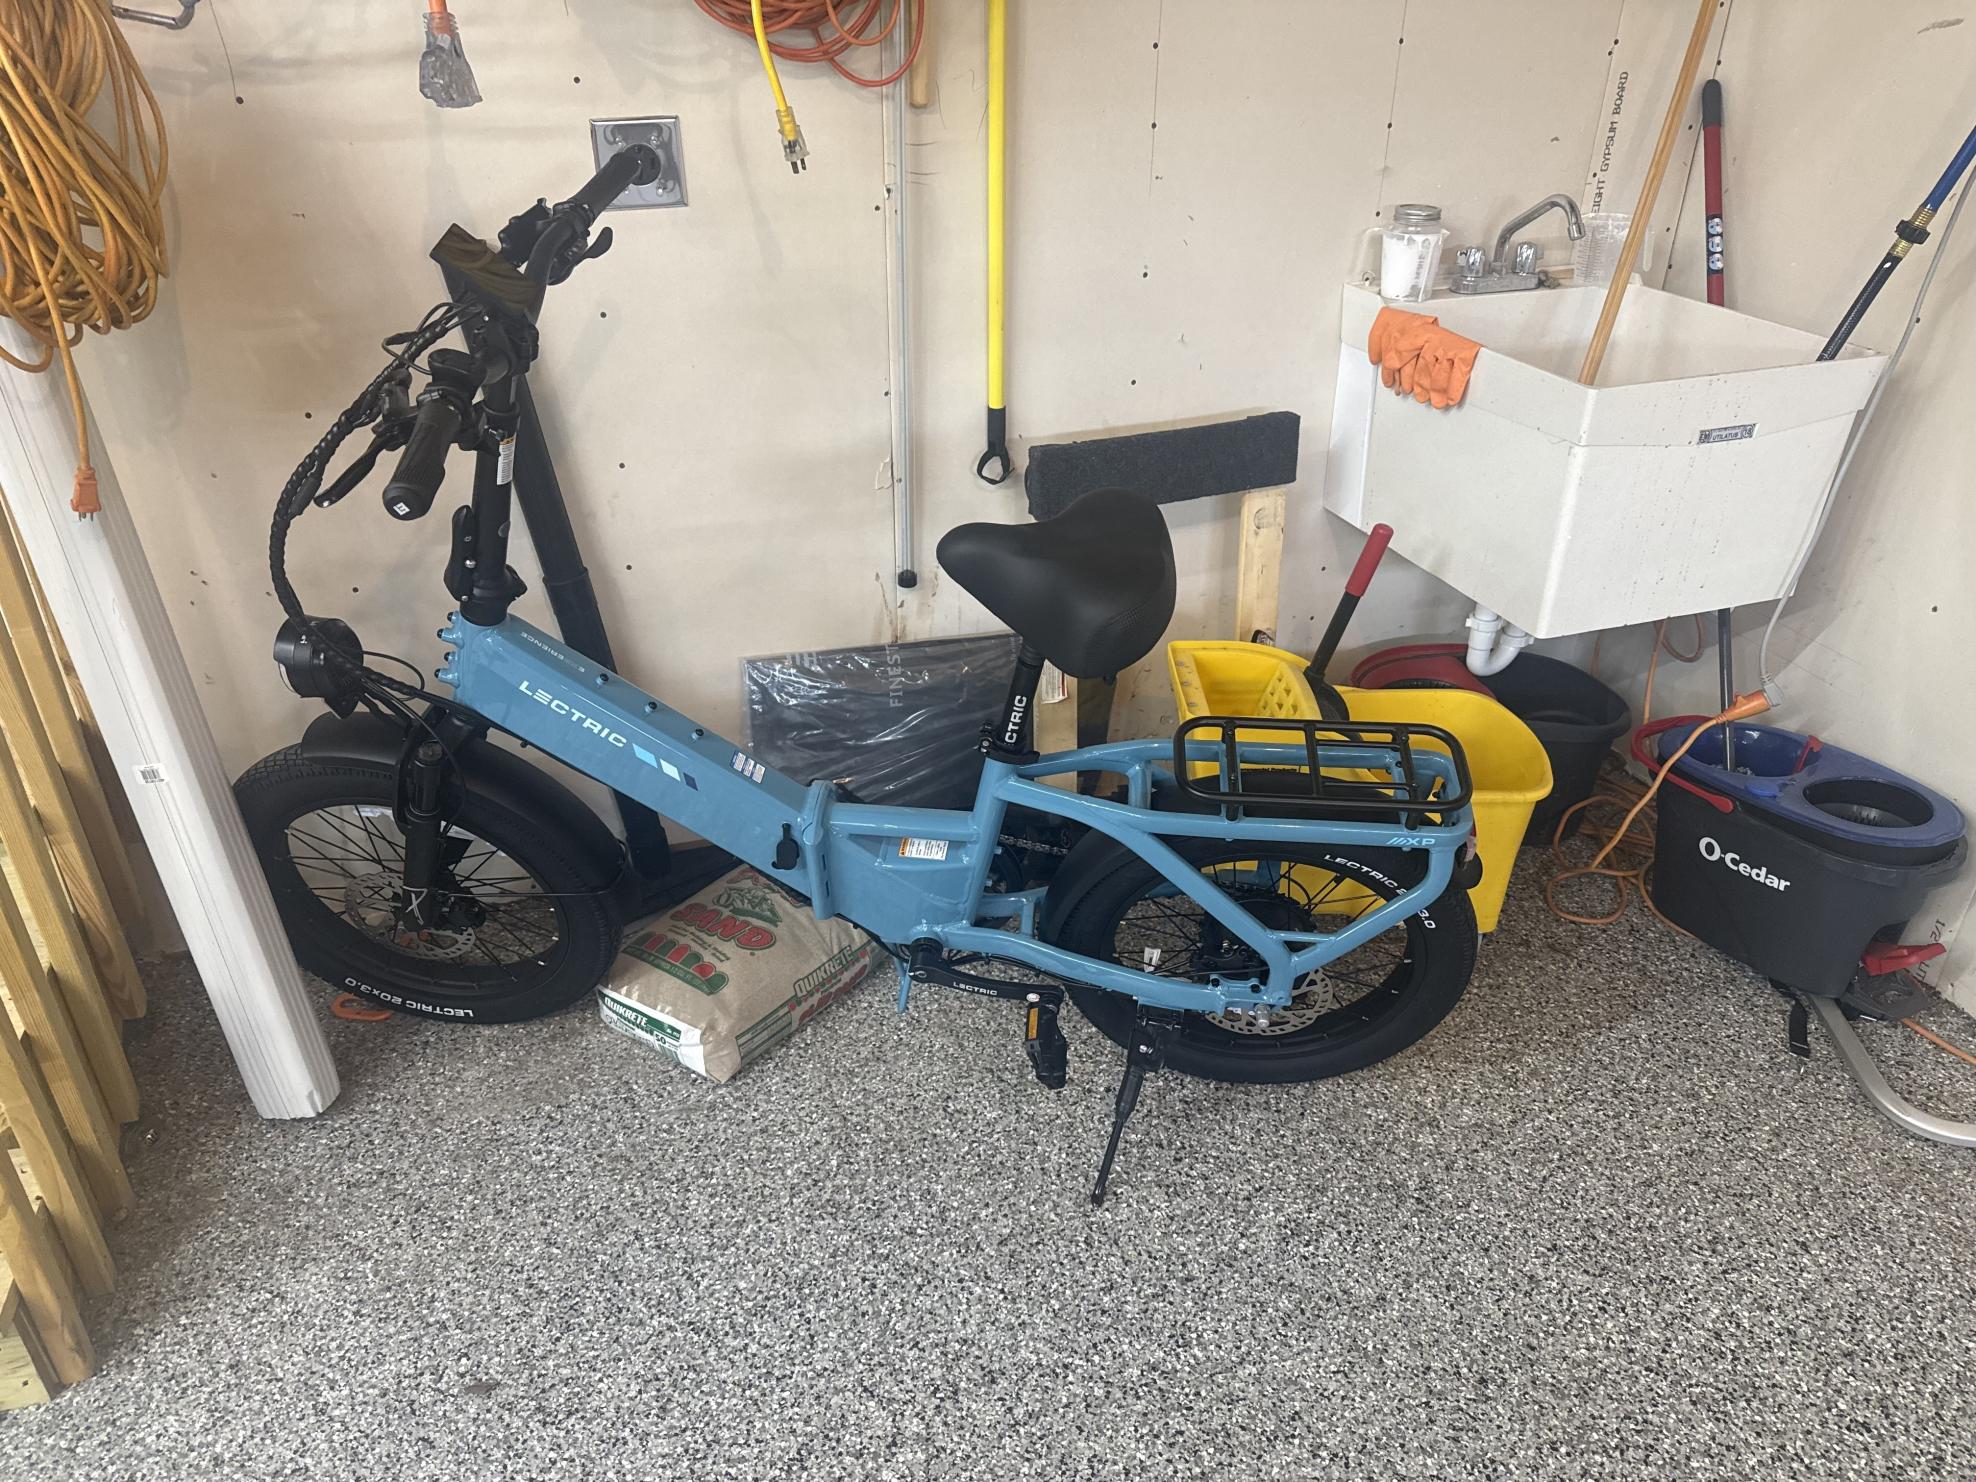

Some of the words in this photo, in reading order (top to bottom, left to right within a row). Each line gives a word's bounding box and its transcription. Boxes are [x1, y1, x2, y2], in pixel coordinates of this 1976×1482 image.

[1600, 121, 1618, 172] GYPSUM
[1612, 71, 1629, 115] BOARD
[885, 643, 904, 707] FINEST
[518, 680, 627, 747] LECTRIC
[1004, 695, 1027, 746] CTRIC
[1323, 854, 1398, 888] LECTRIC
[1699, 836, 1791, 891] O-Cedar
[670, 902, 776, 950] SAND
[344, 977, 402, 1005] 20x3.0
[793, 944, 853, 998] QUIKRETE
[953, 981, 998, 996] LECTRIC
[405, 1000, 474, 1017] LECTRIC
[604, 997, 648, 1027] QUIKRETE
